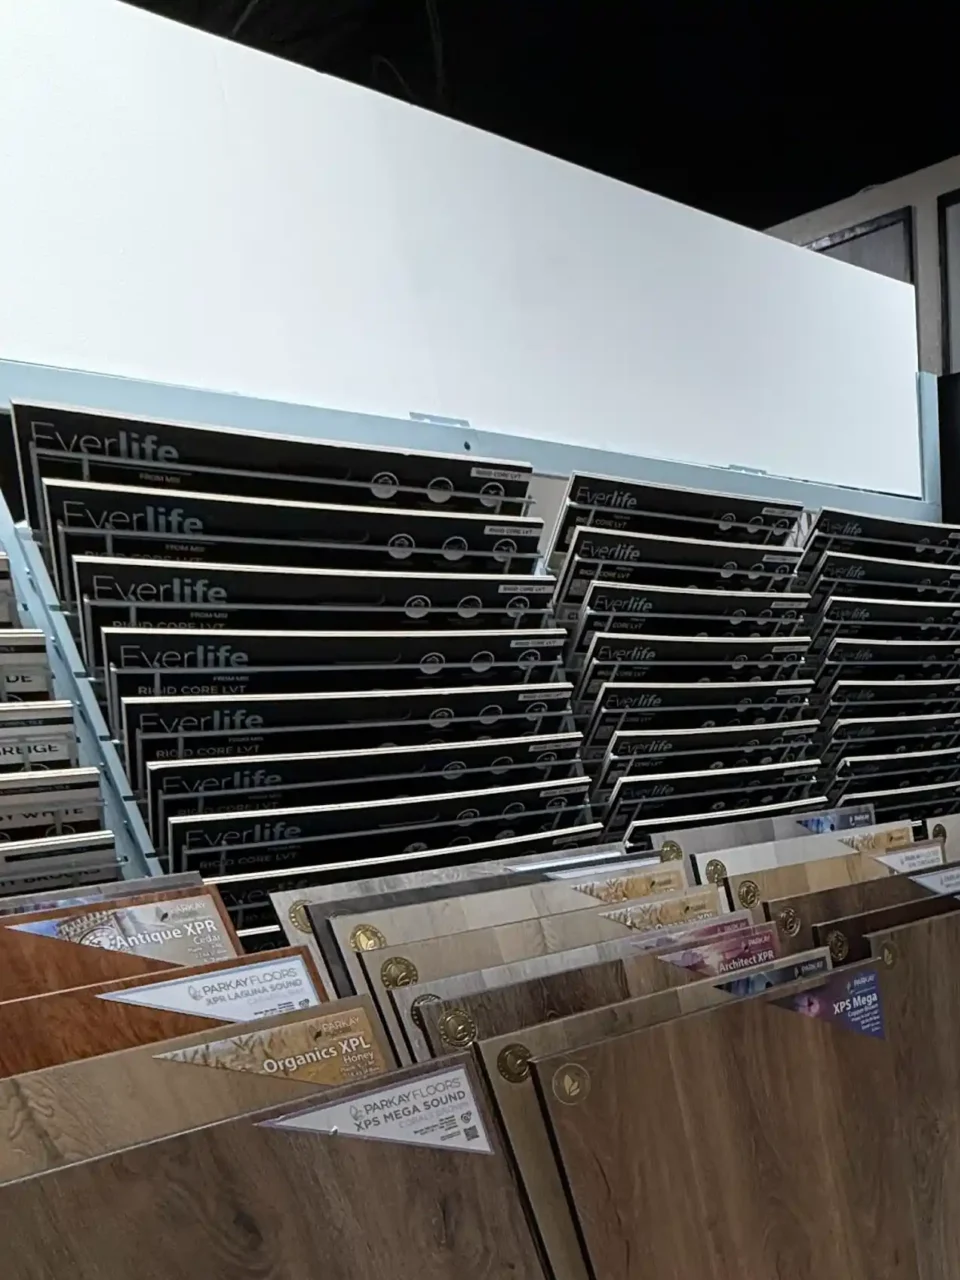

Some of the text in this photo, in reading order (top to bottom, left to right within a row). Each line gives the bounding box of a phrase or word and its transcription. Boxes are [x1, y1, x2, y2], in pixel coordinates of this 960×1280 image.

[31, 421, 179, 464] Everlife
[576, 487, 638, 510] Everlife
[63, 501, 204, 535] Everlife
[579, 540, 641, 562] Everlife
[92, 575, 228, 605] Everlife
[593, 594, 653, 613] Everlife
[120, 645, 249, 668] Everlife
[598, 645, 657, 661] Everlife
[181, 685, 218, 695] CORE
[222, 685, 247, 694] LVT
[139, 710, 263, 734] Everlife
[197, 747, 233, 757] CORE
[237, 745, 260, 754] LVT
[163, 769, 282, 794] Everlife
[185, 821, 301, 847] Everlife
[114, 919, 218, 949] Antique XPR
[718, 951, 775, 973] Architect XPR
[228, 987, 269, 1001] LAGUNA
[270, 979, 302, 991] SOUND
[833, 993, 878, 1015] XPS Mega
[322, 1016, 360, 1032] PARKAY
[263, 1046, 338, 1074] Organics
[338, 1036, 371, 1054] XPL
[343, 1051, 374, 1064] Honey
[354, 1116, 381, 1132] XPS
[384, 1104, 421, 1123] MEGA
[423, 1090, 466, 1110] SOUND
